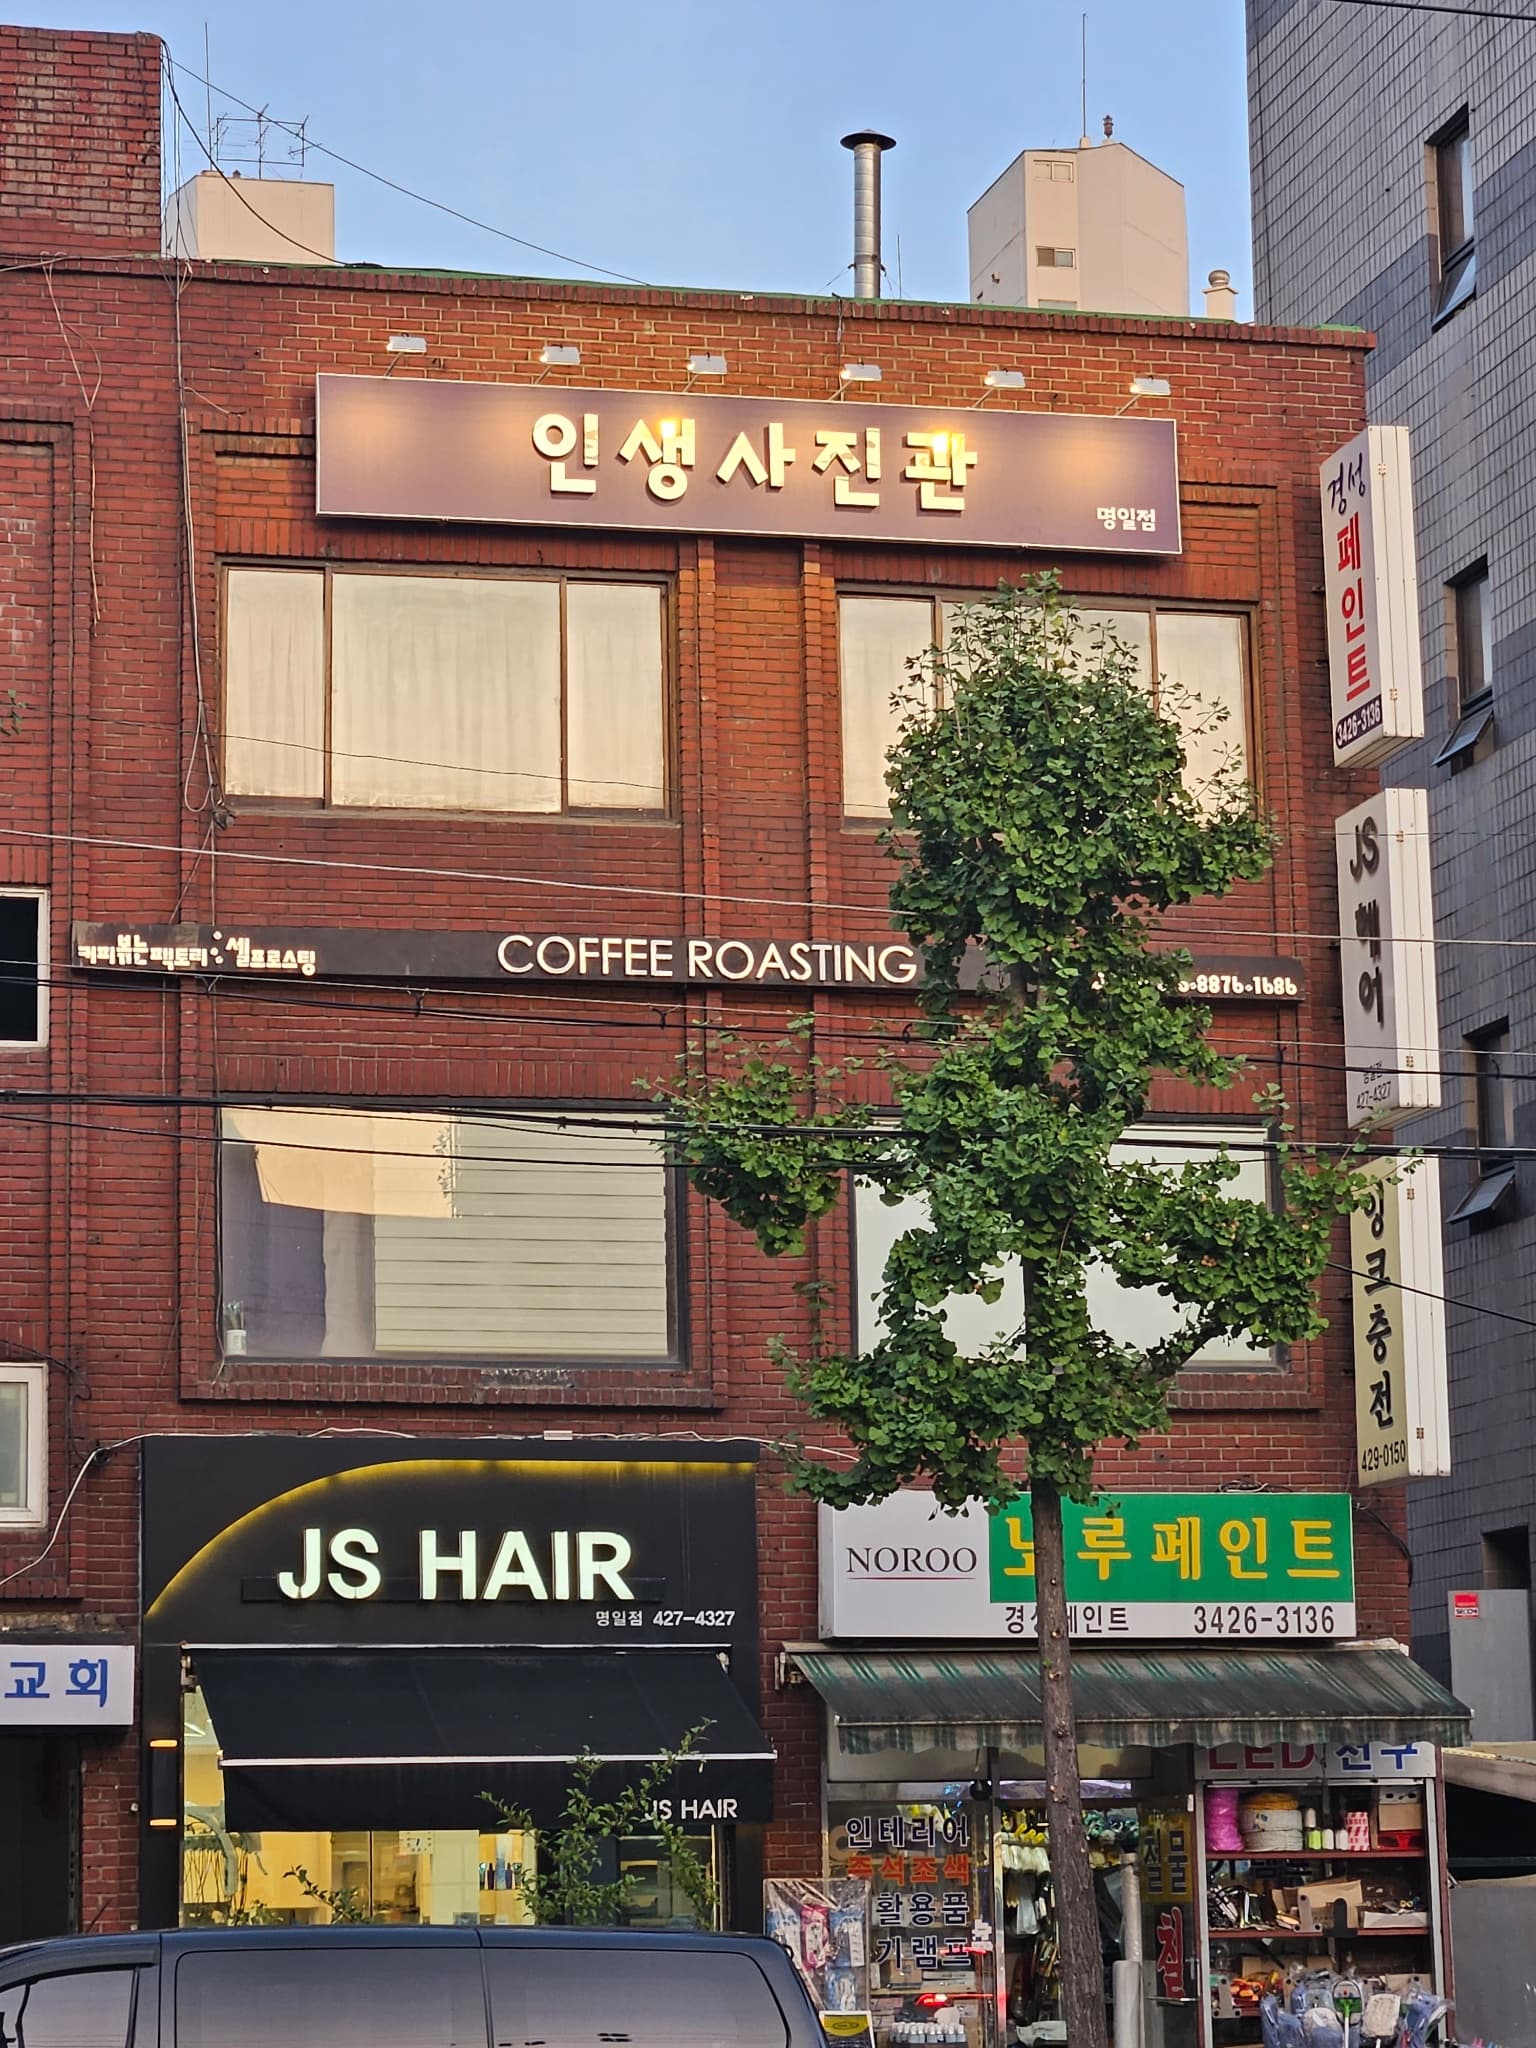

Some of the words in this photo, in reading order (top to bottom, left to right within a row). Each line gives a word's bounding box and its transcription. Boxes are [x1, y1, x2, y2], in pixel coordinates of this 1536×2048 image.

[532, 412, 978, 512] 인생사진관
[1327, 452, 1367, 516] 경성
[1096, 506, 1158, 533] 명일점
[1337, 511, 1370, 702] 페인트
[1336, 700, 1381, 748] 3426-3136
[1349, 815, 1380, 883] JS
[225, 937, 316, 977] 셀프로스팅
[497, 934, 673, 978] COFFEE
[688, 940, 918, 984] ROASTING
[1361, 1439, 1406, 1473] 429-0150
[278, 1527, 382, 1600] JS
[419, 1529, 635, 1600] HAIR
[846, 1546, 977, 1574] NOROO
[595, 1610, 643, 1627] 명일점
[652, 1610, 735, 1627] 427-4327
[1193, 1605, 1335, 1635] 3426-3136
[4, 1658, 109, 1709] 교회
[644, 1799, 673, 1820] JS
[681, 1798, 738, 1820] HAIR
[845, 1815, 969, 1848] 인테리어
